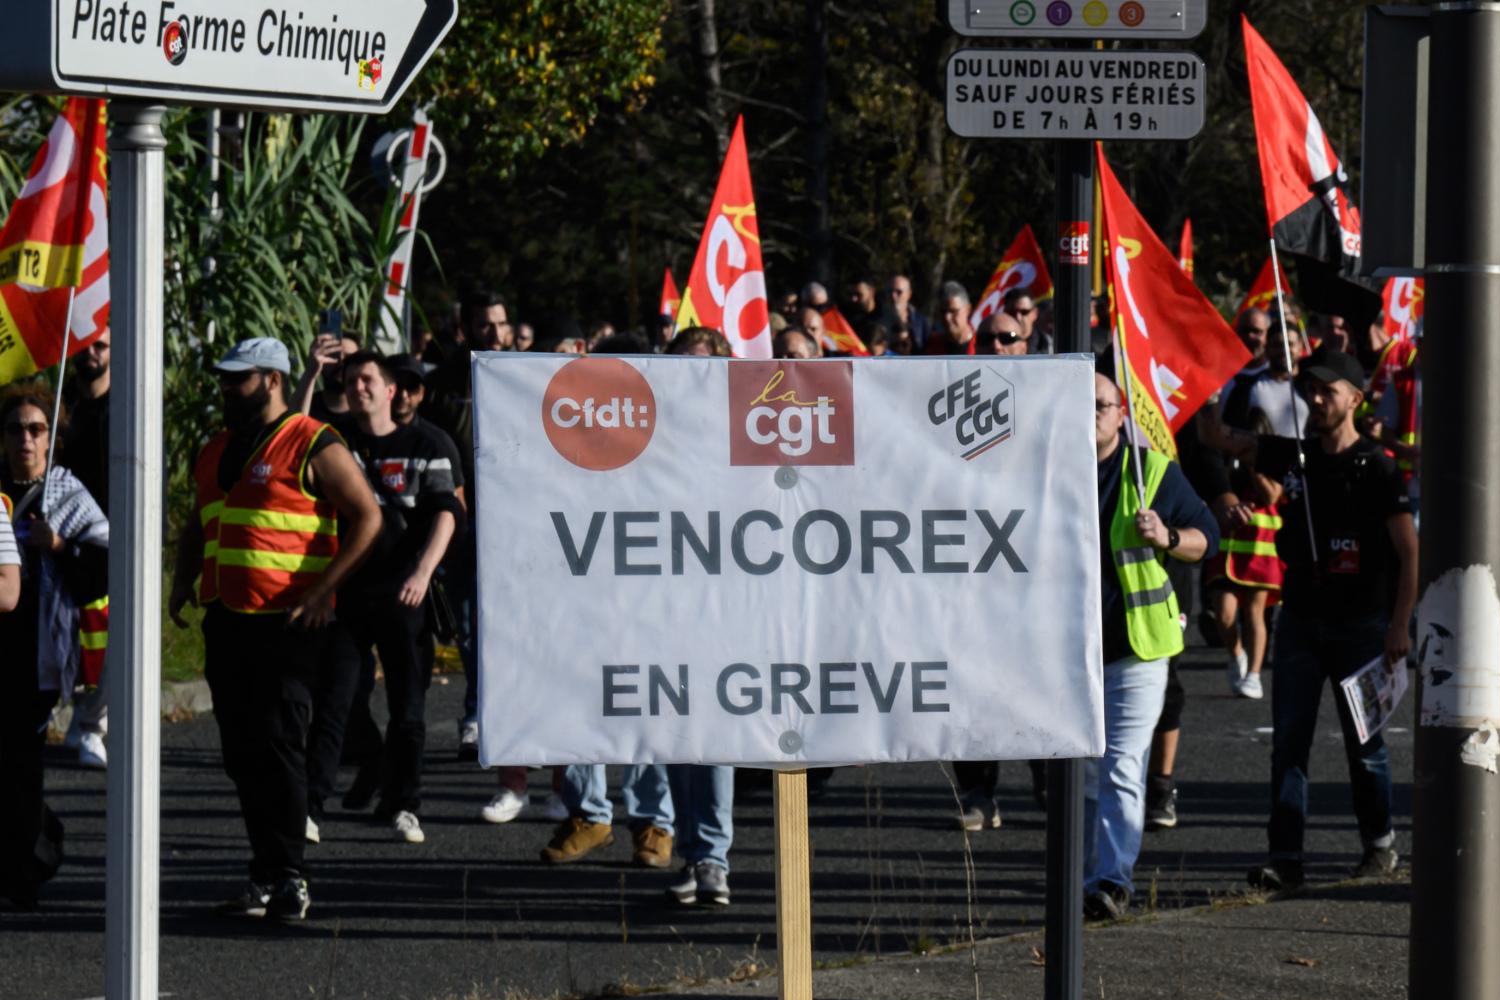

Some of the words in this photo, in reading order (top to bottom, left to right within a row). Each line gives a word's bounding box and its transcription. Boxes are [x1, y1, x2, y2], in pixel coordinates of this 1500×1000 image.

[1055, 7, 1064, 19] 1
[1127, 8, 1137, 20] 3
[72, 0, 147, 45] Plate
[257, 9, 386, 76] Chimique
[954, 58, 982, 77] DU
[987, 59, 1049, 78] LUNDI
[1055, 59, 1084, 79] AU
[1089, 60, 1197, 80] VENDREDI
[955, 84, 1017, 103] SAUF
[1025, 85, 1104, 104] JOURS
[1112, 82, 1196, 105] FÉRIÉS
[993, 111, 1025, 129] DE
[1084, 107, 1098, 130] À
[1060, 233, 1088, 255] cgt
[750, 369, 835, 406] la
[928, 368, 982, 426] CFE
[745, 395, 836, 457] cgt
[955, 389, 1010, 446] CGC
[549, 508, 1029, 577] VENCOREX
[602, 663, 690, 717] EN
[716, 660, 951, 716] GREVE
